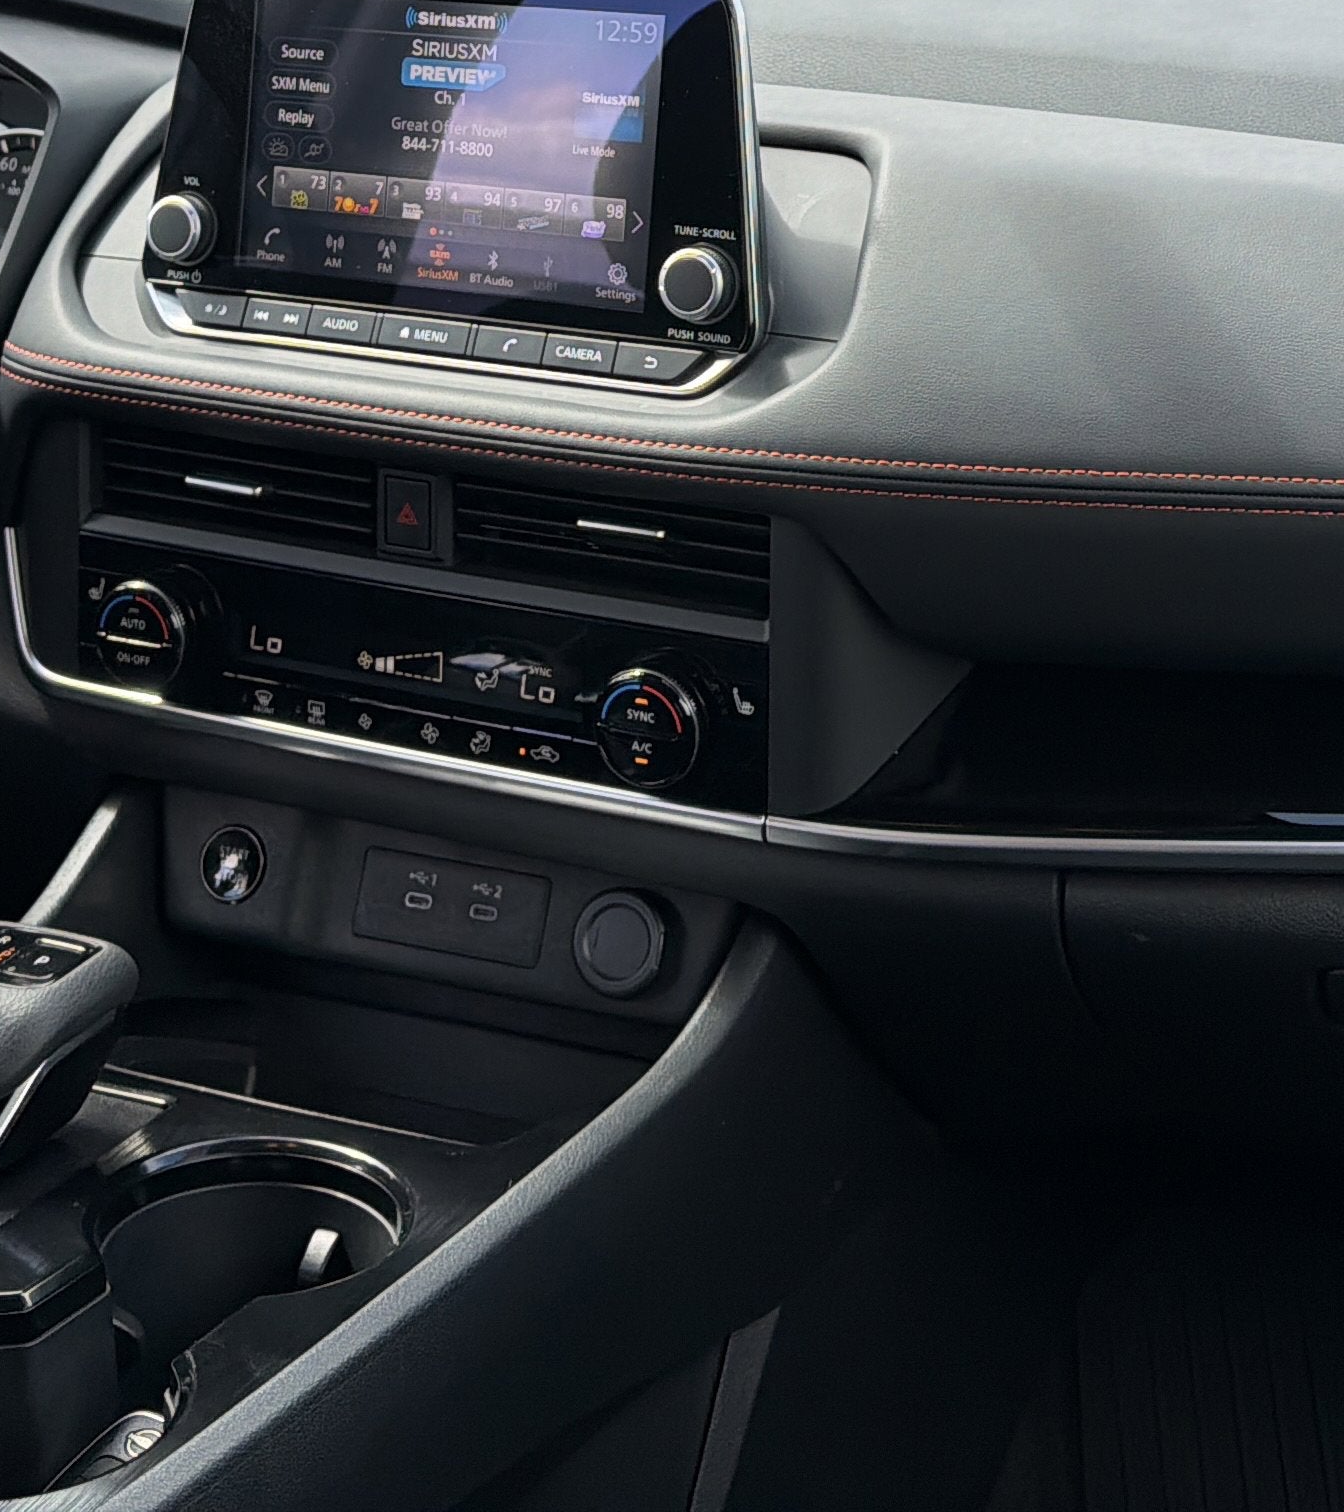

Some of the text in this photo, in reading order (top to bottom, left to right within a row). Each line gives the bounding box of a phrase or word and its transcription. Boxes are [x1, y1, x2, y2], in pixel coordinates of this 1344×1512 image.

[595, 19, 657, 44] 12:59
[281, 44, 324, 60] Source
[412, 39, 497, 61] SIRIUSXM
[410, 64, 497, 85] PREVIEW
[271, 75, 330, 94] SXM Menu
[434, 90, 455, 105] Ch.
[581, 91, 640, 107] SiriusXM
[278, 108, 315, 128] Replay
[391, 117, 507, 138] Great Offer Now!
[401, 136, 494, 157] 844-711-8800
[572, 144, 616, 158] Live Mode
[0, 157, 18, 173] 60
[184, 175, 200, 187] VOL
[310, 175, 327, 190] 73
[375, 182, 384, 195] 7
[425, 187, 442, 201] 93
[483, 192, 501, 207] 94
[544, 197, 562, 212] 97
[606, 204, 624, 219] 98
[256, 249, 286, 263] Phone
[324, 258, 342, 268] AM
[167, 269, 190, 281] PUSH
[377, 263, 393, 274] FM
[417, 267, 459, 281] SiriusXM
[469, 273, 514, 288] BT Audio
[594, 286, 637, 302] Settings
[323, 316, 359, 332] AUDIO
[414, 329, 448, 345] MENU
[667, 328, 731, 344] PUSH SOUND
[556, 345, 602, 363] CAMERA
[120, 616, 146, 631] AUTO
[249, 624, 283, 654] Lo
[528, 665, 553, 678] SYNC
[520, 674, 555, 704] Lo
[626, 708, 655, 724] SYNC
[632, 740, 653, 754] A/C
[33, 955, 51, 965] P
